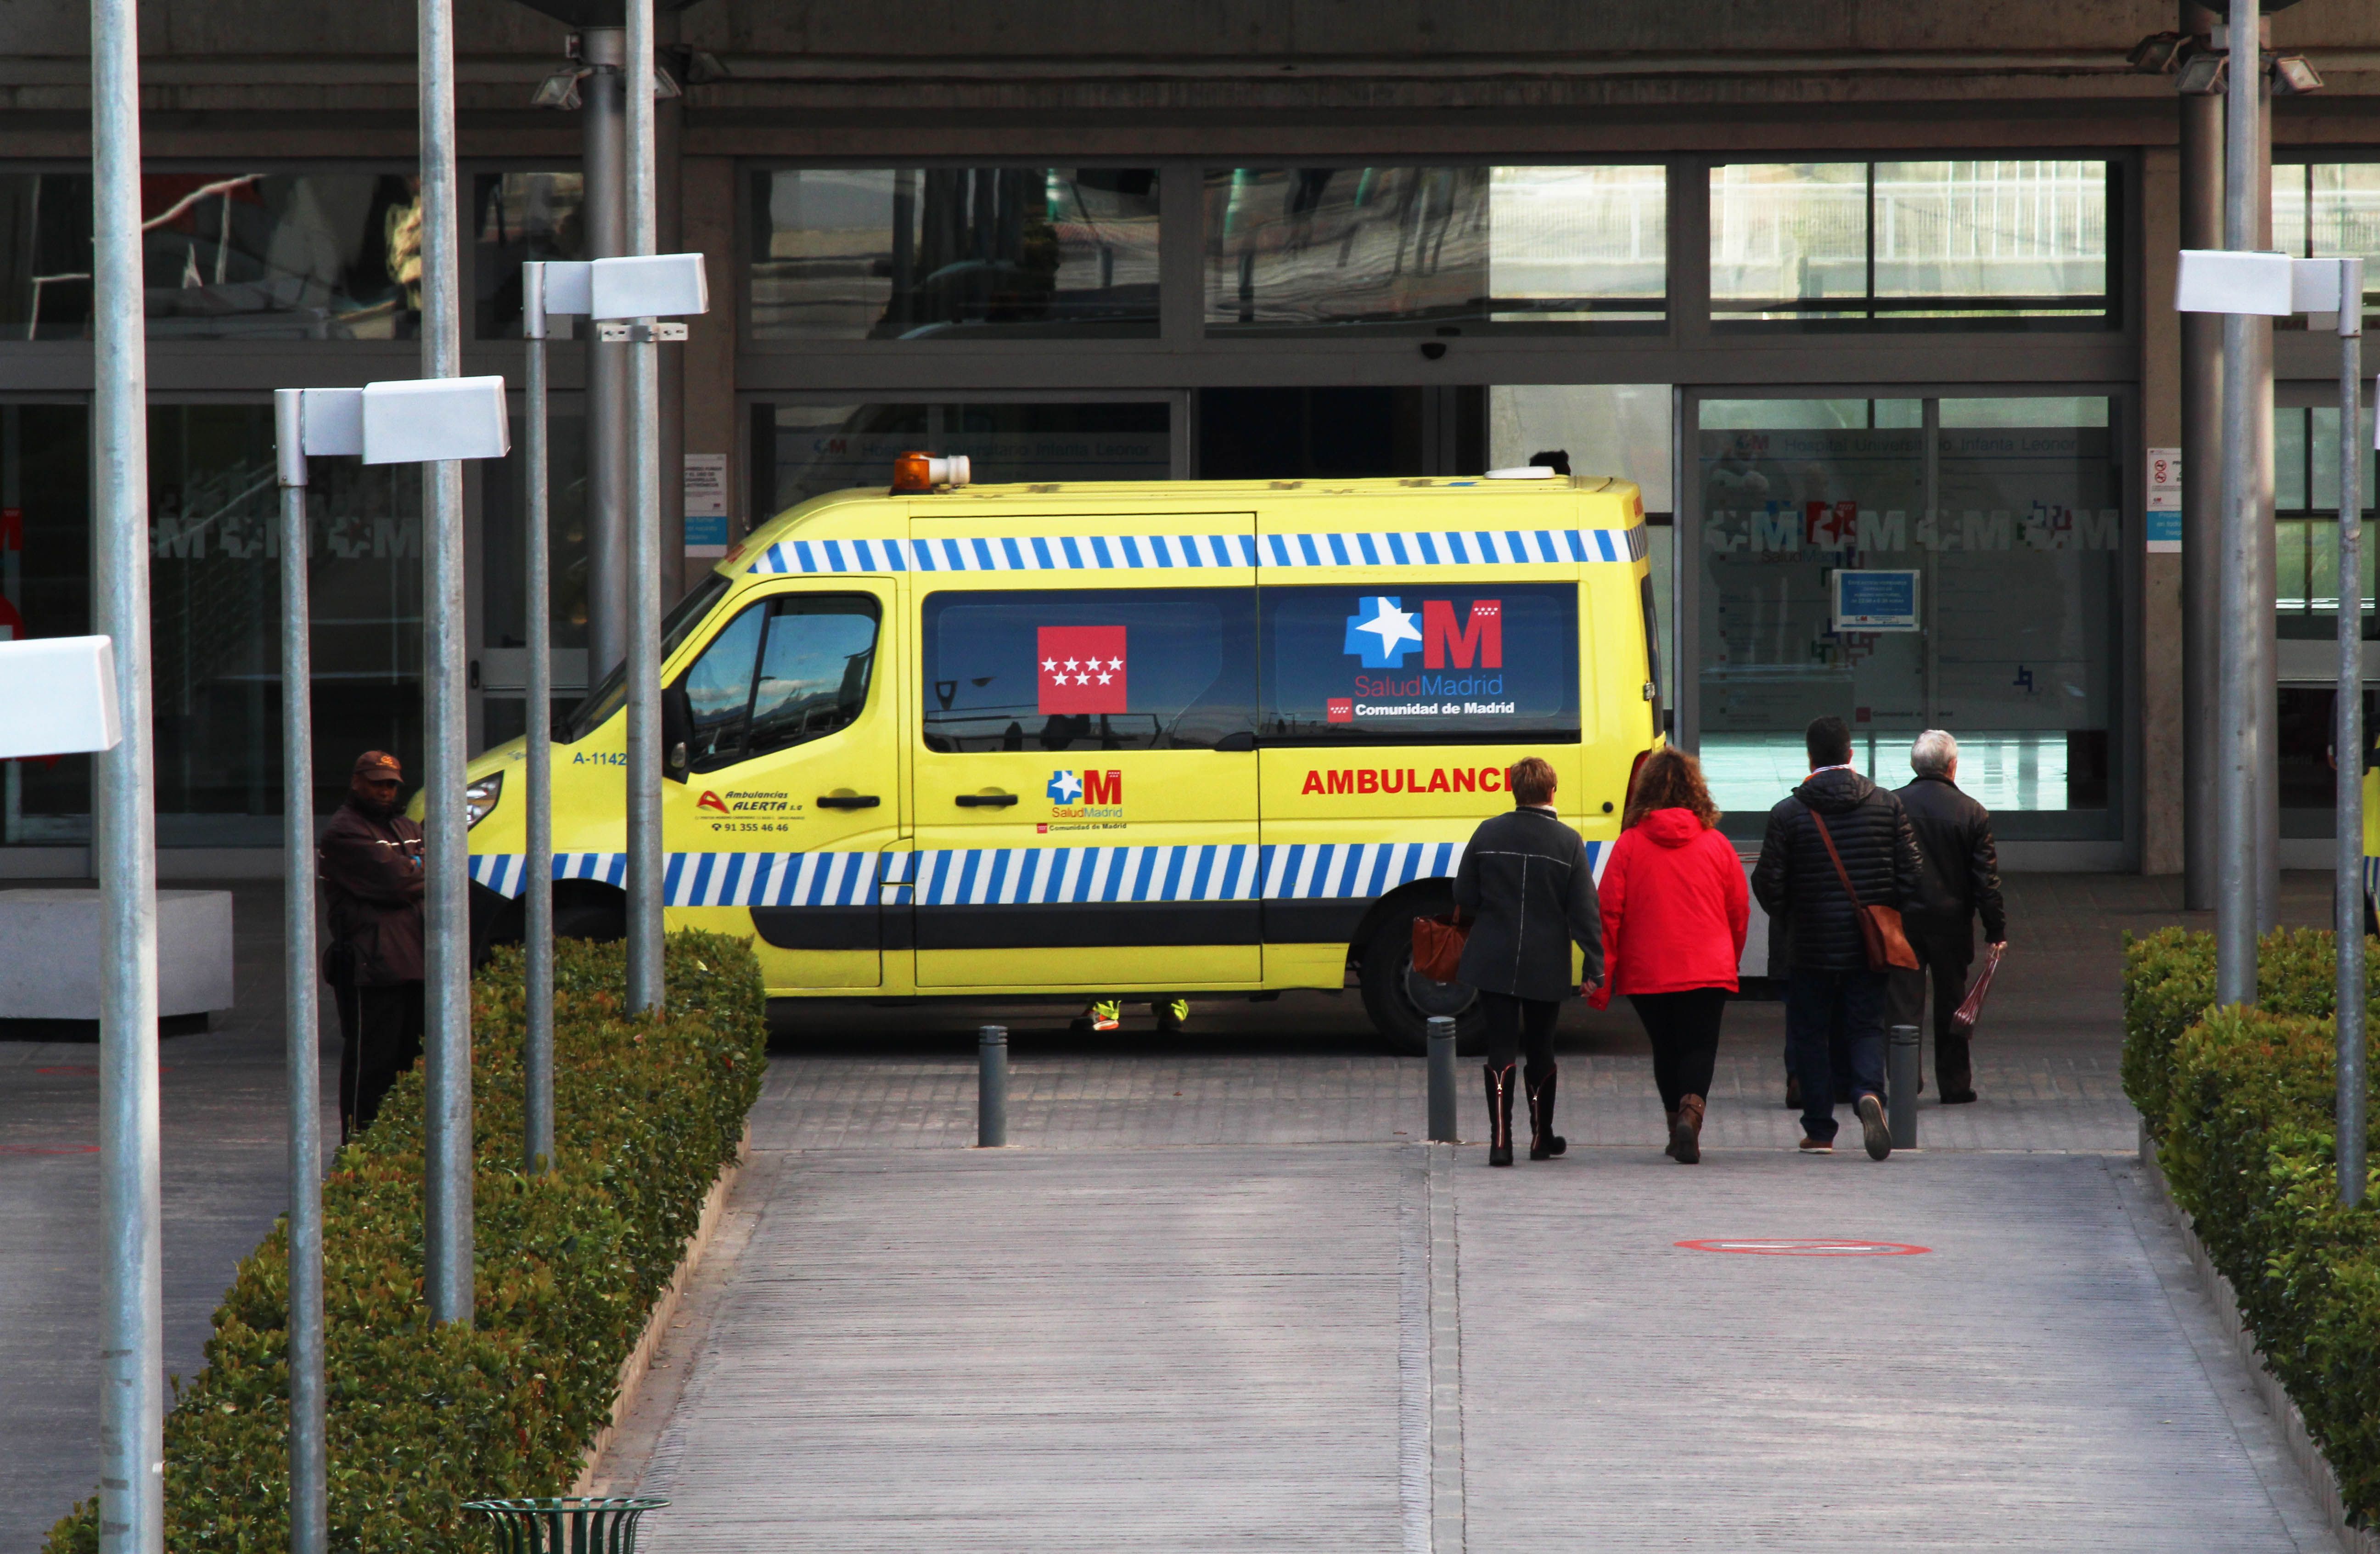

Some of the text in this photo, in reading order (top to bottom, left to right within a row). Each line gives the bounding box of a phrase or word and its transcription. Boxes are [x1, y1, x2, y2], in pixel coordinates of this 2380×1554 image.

[943, 442, 1028, 456] niversitario
[1036, 442, 1088, 456] Infanta
[1096, 442, 1150, 456] Leonor
[1784, 437, 2076, 454] Hospital Universitio Infanta Leonor
[373, 518, 421, 558] M
[1750, 509, 2119, 552] M M M M
[1423, 599, 1502, 669] M
[1355, 674, 1503, 697] SaludMadrid
[1355, 702, 1515, 716] Comunidad de Madrid
[573, 752, 627, 766] A-1142
[1084, 770, 1122, 805] M
[1301, 767, 1513, 795] AMBULANCI
[725, 791, 788, 799] Ambulancias
[732, 801, 787, 811] ALERTA
[1051, 807, 1123, 818] SaludMadrid
